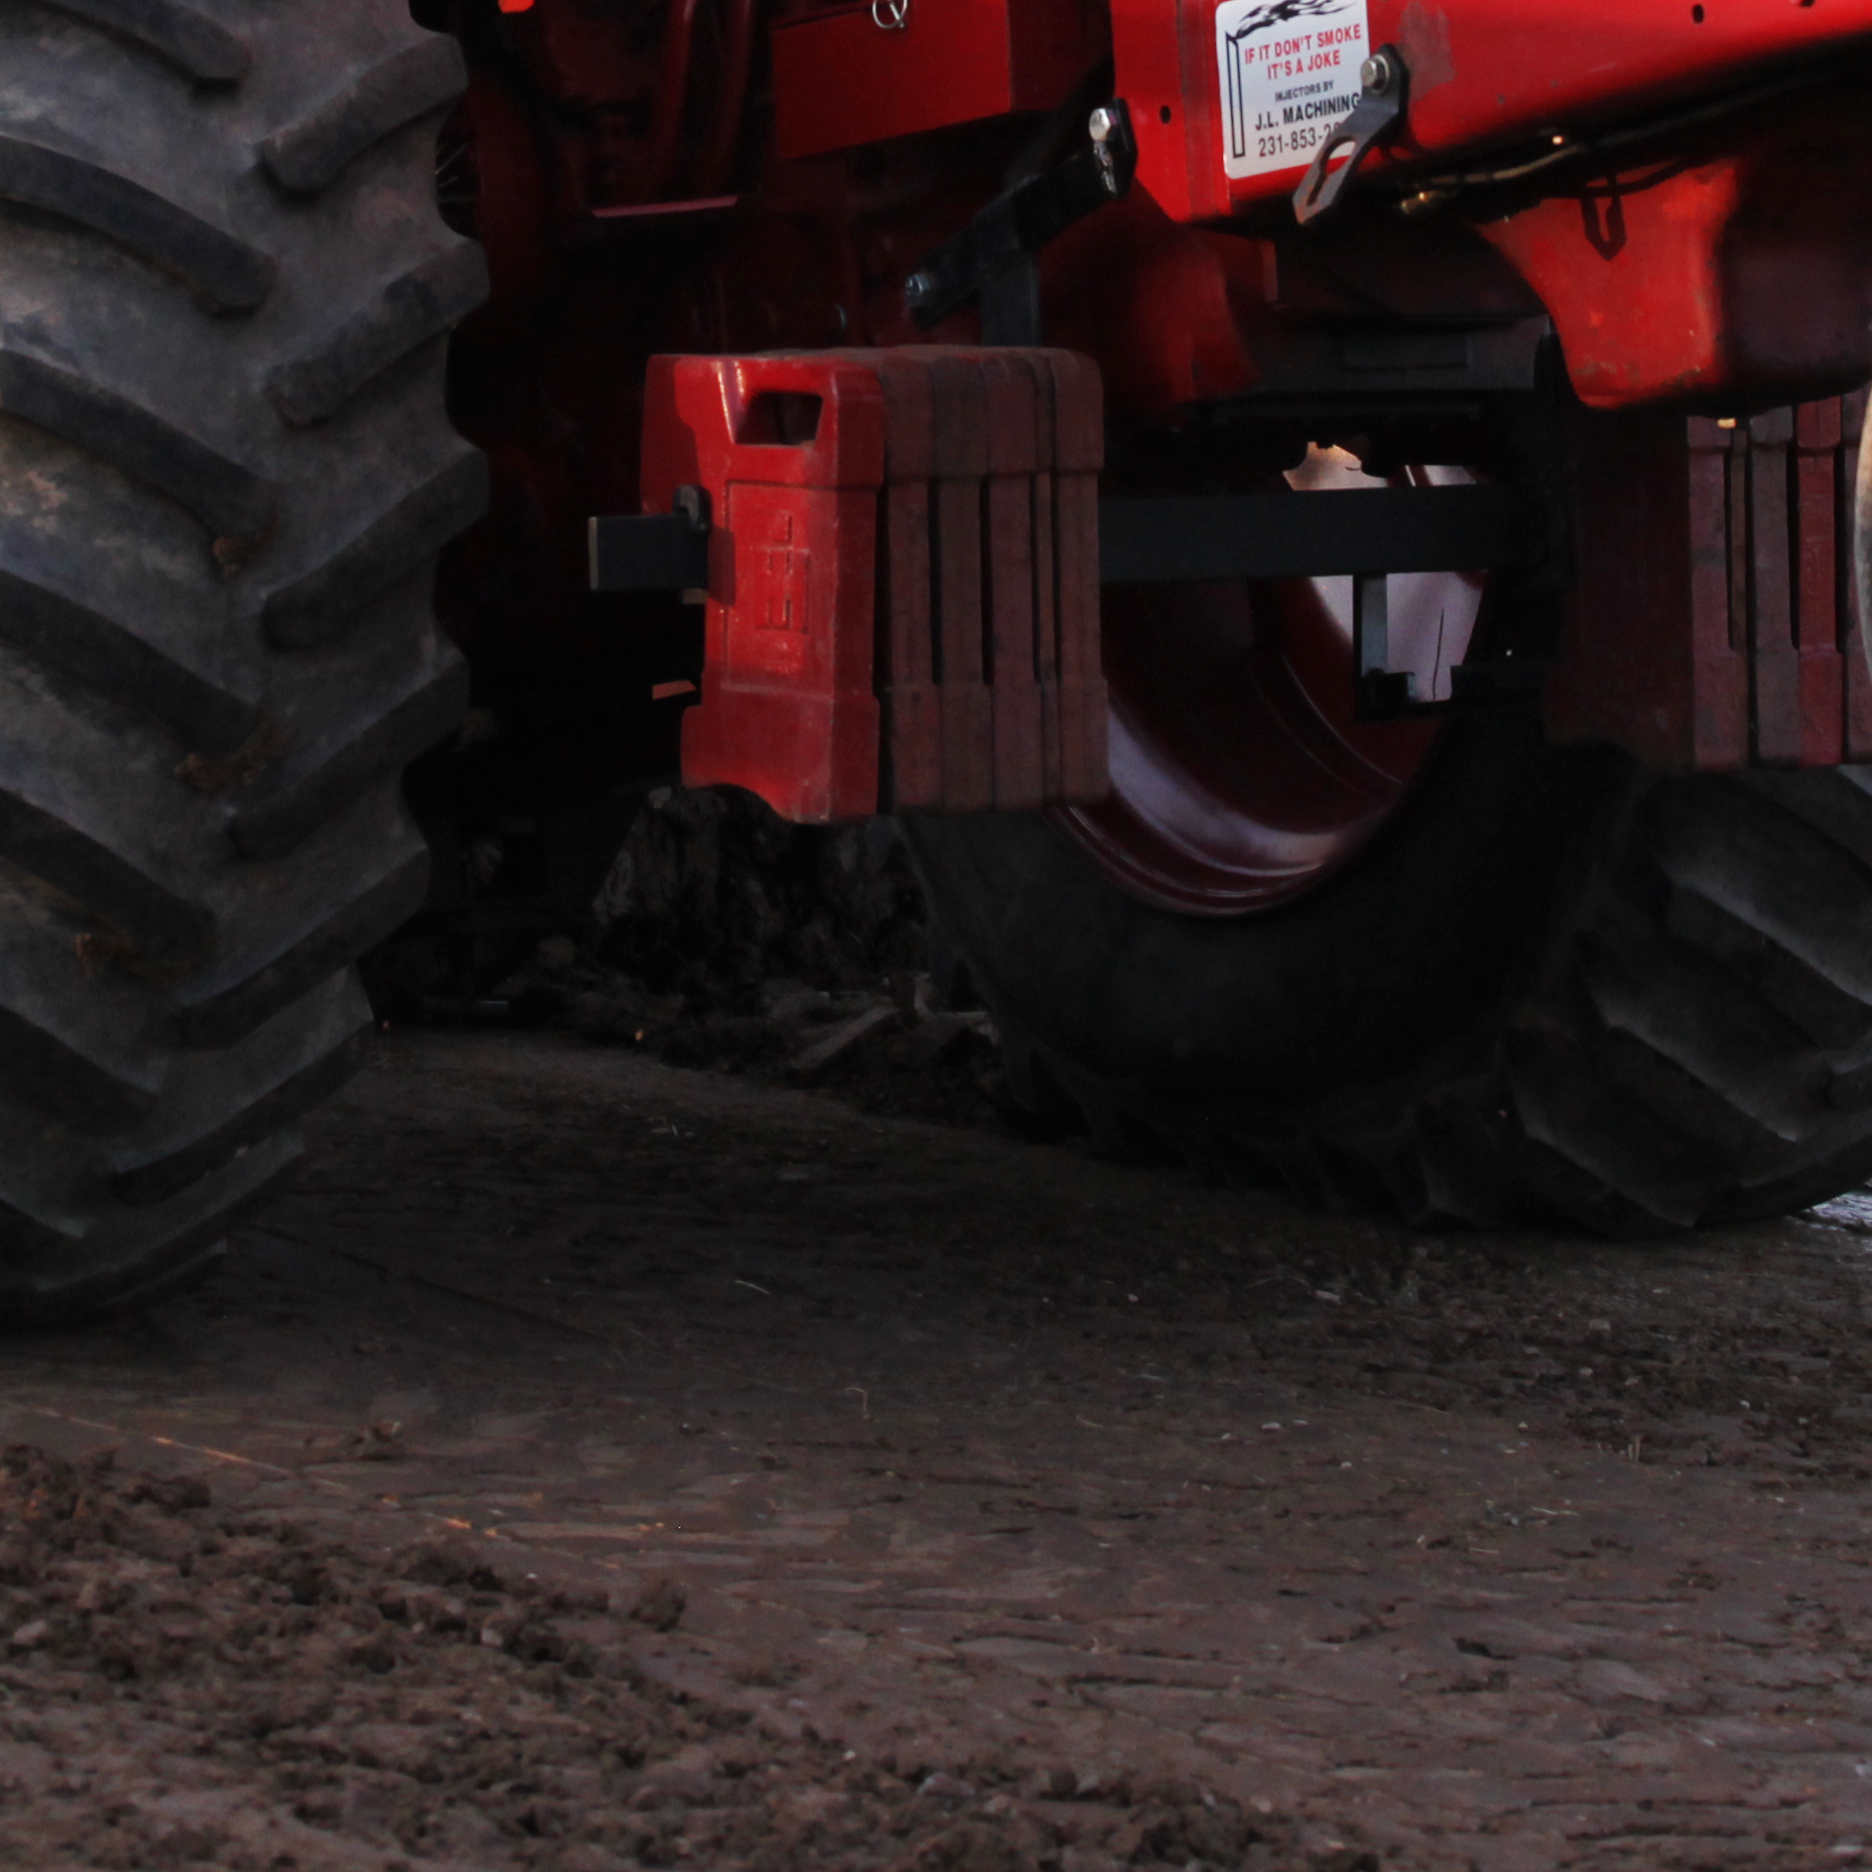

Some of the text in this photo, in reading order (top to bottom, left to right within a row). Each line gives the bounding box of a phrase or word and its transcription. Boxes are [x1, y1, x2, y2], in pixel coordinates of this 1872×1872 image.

[1245, 23, 1361, 64] IF IT DON'T SMOKE
[1267, 49, 1341, 80] IT'S A JOKE
[1275, 79, 1334, 102] INJECTORS BY
[1255, 92, 1361, 131] J.L. MACHINING
[1258, 121, 1343, 157] 231-853-2
